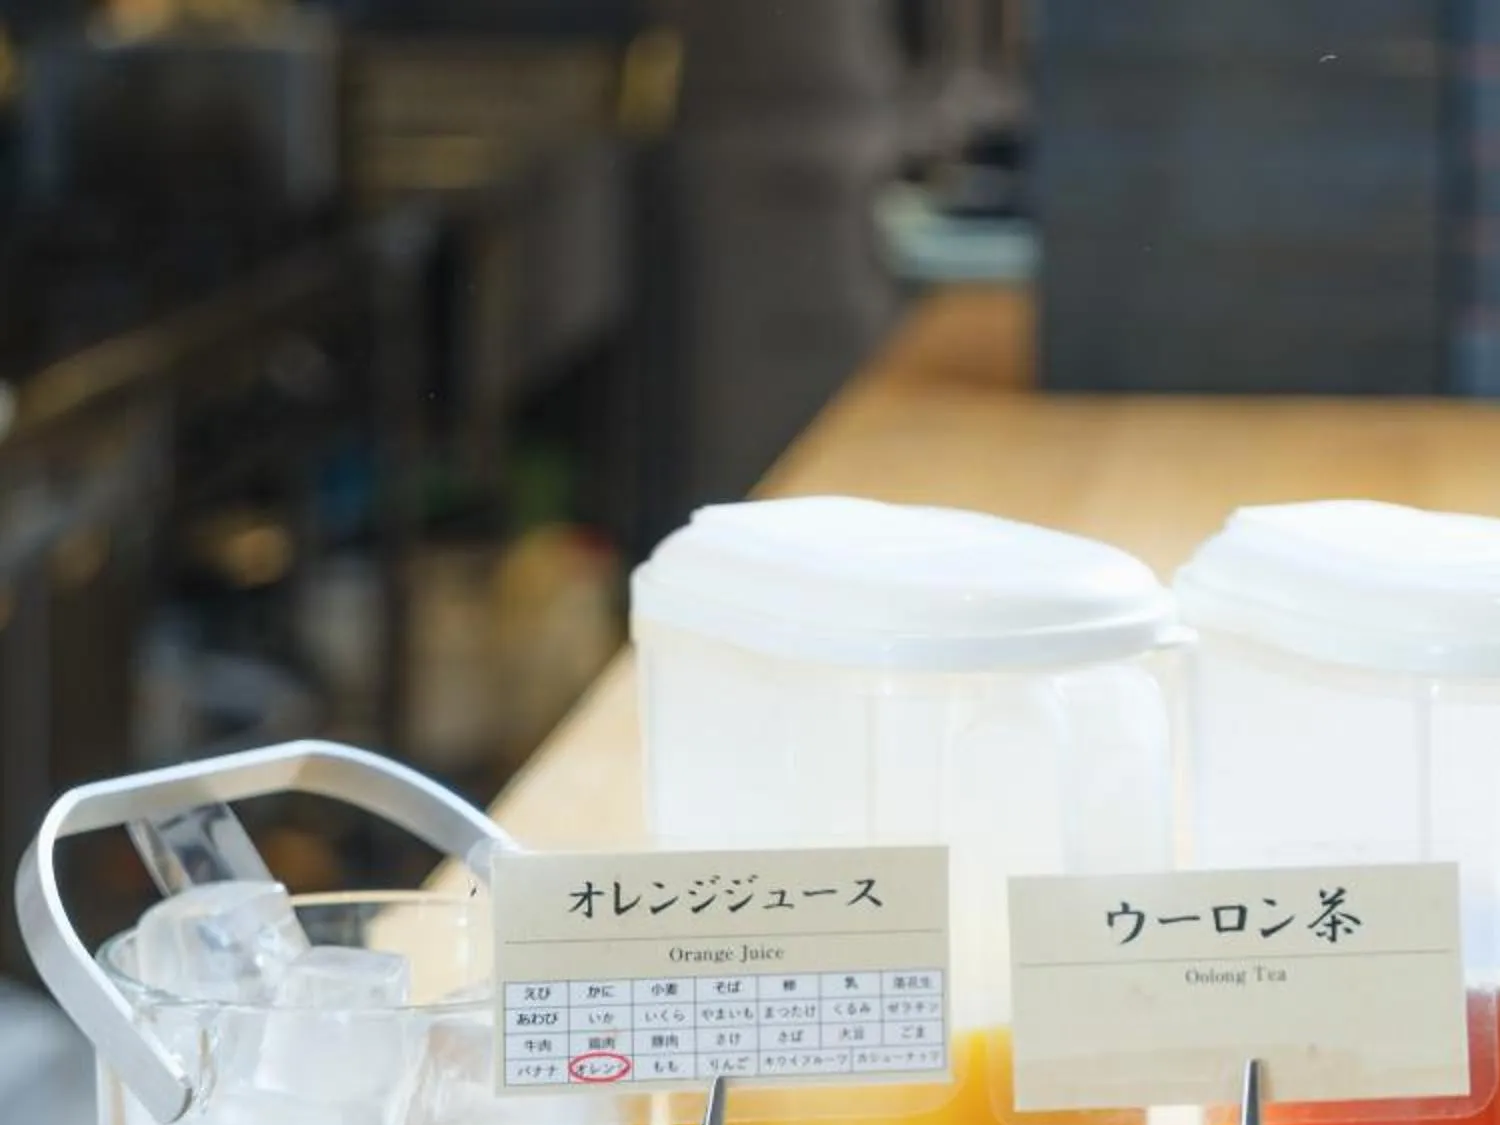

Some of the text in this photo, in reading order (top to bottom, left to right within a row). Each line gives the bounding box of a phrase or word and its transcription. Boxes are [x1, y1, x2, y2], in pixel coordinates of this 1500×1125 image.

[568, 874, 883, 918] オレンジジュース
[1106, 887, 1362, 944] ウーロン茶
[669, 944, 786, 963] Orange Juice
[1185, 965, 1287, 986] Oolong Tea
[525, 987, 551, 1000] えび
[586, 985, 614, 998] かに
[713, 980, 741, 994] そば
[516, 1012, 558, 1026] あわび
[588, 1012, 614, 1024] いか
[645, 1010, 686, 1022] いくら
[702, 1007, 754, 1021] やまいも
[765, 1005, 816, 1019] まつたけ
[833, 1003, 871, 1016] くるみ
[524, 1039, 552, 1052] 牛肉
[716, 1032, 741, 1046] さけ
[901, 1025, 925, 1039] ごま
[654, 1060, 678, 1073] もも
[709, 1056, 749, 1071] りんご
